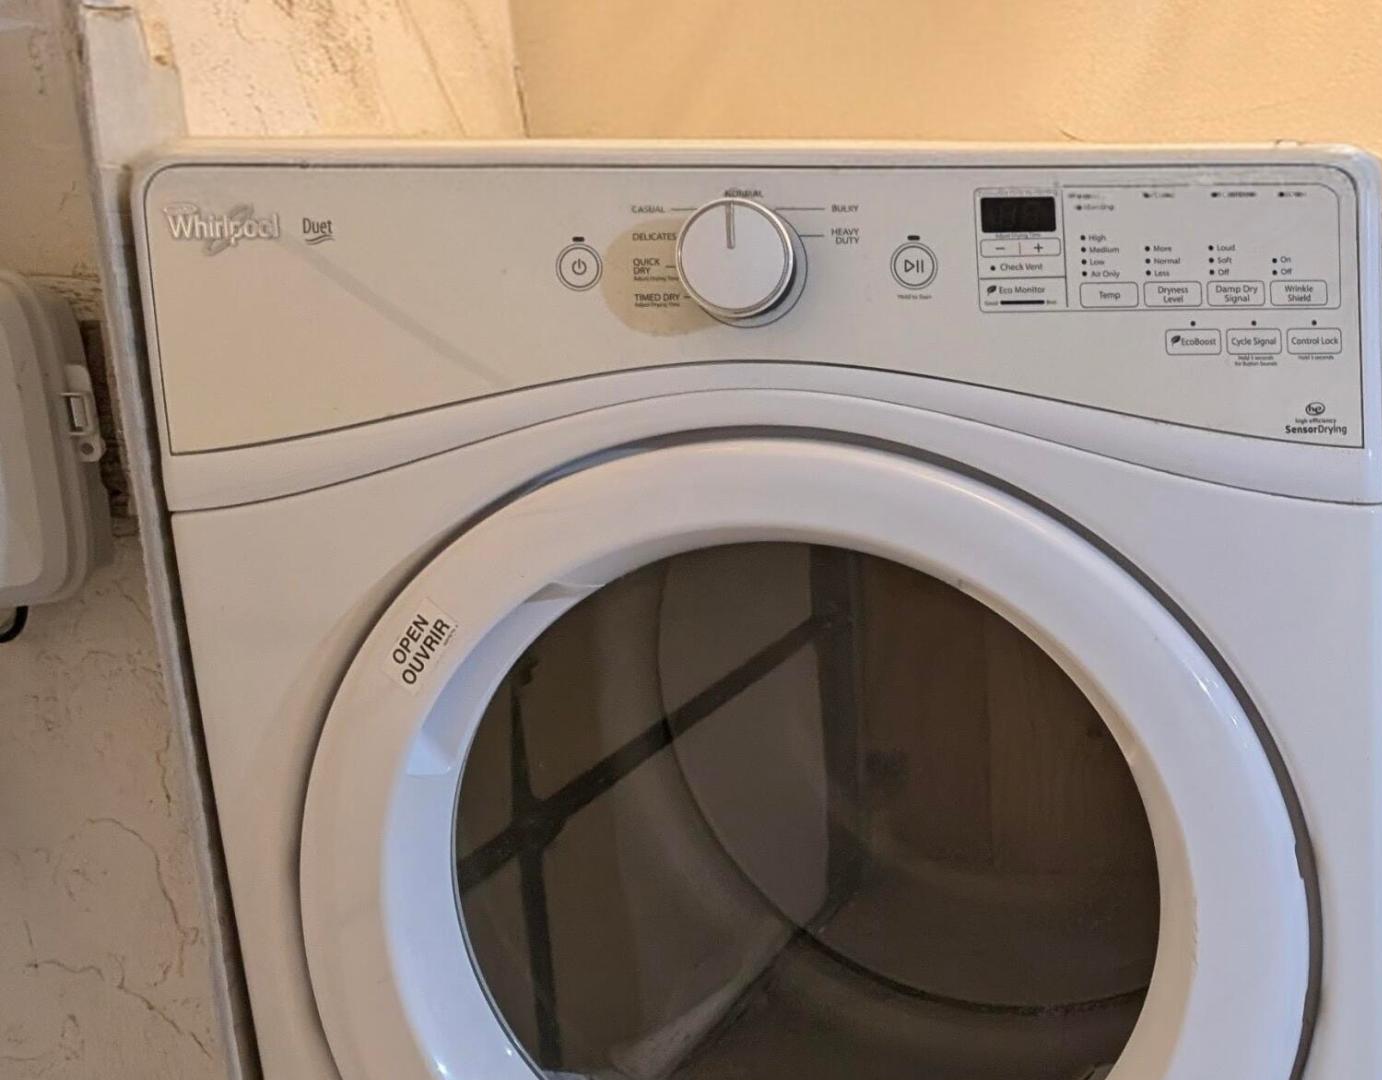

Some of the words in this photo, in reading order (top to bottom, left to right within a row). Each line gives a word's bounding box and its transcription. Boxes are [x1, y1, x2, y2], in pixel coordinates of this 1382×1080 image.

[631, 205, 665, 214] CASUAL
[831, 204, 859, 213] BULKY
[165, 206, 280, 250] Whirlpool
[302, 217, 333, 234] Duet
[631, 232, 677, 241] DELICATES
[831, 228, 860, 236] HEAVY
[835, 237, 860, 245] DUTY
[1088, 235, 1106, 243] High
[1089, 246, 1120, 254] Medium
[1153, 244, 1172, 252] More
[1216, 243, 1236, 252] Loud
[632, 258, 660, 267] QUICK
[1153, 257, 1181, 265] Normal
[1217, 256, 1232, 264] Soft
[1279, 255, 1292, 263] On
[632, 267, 651, 275] DRY
[1000, 263, 1024, 271] Check
[1025, 262, 1043, 271] Vent
[1279, 267, 1293, 275] Off
[1102, 270, 1120, 279] Only
[1217, 268, 1230, 276] Off
[998, 286, 1013, 294] Eco
[1014, 285, 1046, 294] Monitor
[1157, 285, 1189, 295] Dryness
[1215, 285, 1241, 295] Damp
[1242, 284, 1258, 294] Dry
[1284, 284, 1314, 293] Wrinkle
[634, 293, 661, 301] TIMED
[662, 293, 680, 301] DRY
[1099, 290, 1121, 300] Temp
[1163, 295, 1184, 303] Level
[1224, 294, 1250, 304] Signal
[1287, 294, 1312, 302] Shield
[1181, 337, 1217, 346] EcoBoost
[1231, 337, 1251, 347] Cycle
[1253, 336, 1277, 346] Signal
[1291, 336, 1320, 345] Control
[1321, 336, 1339, 345] Lock
[1285, 424, 1348, 436] SensorDrying
[393, 614, 429, 665] OPEN
[402, 619, 450, 685] OUVRIR
